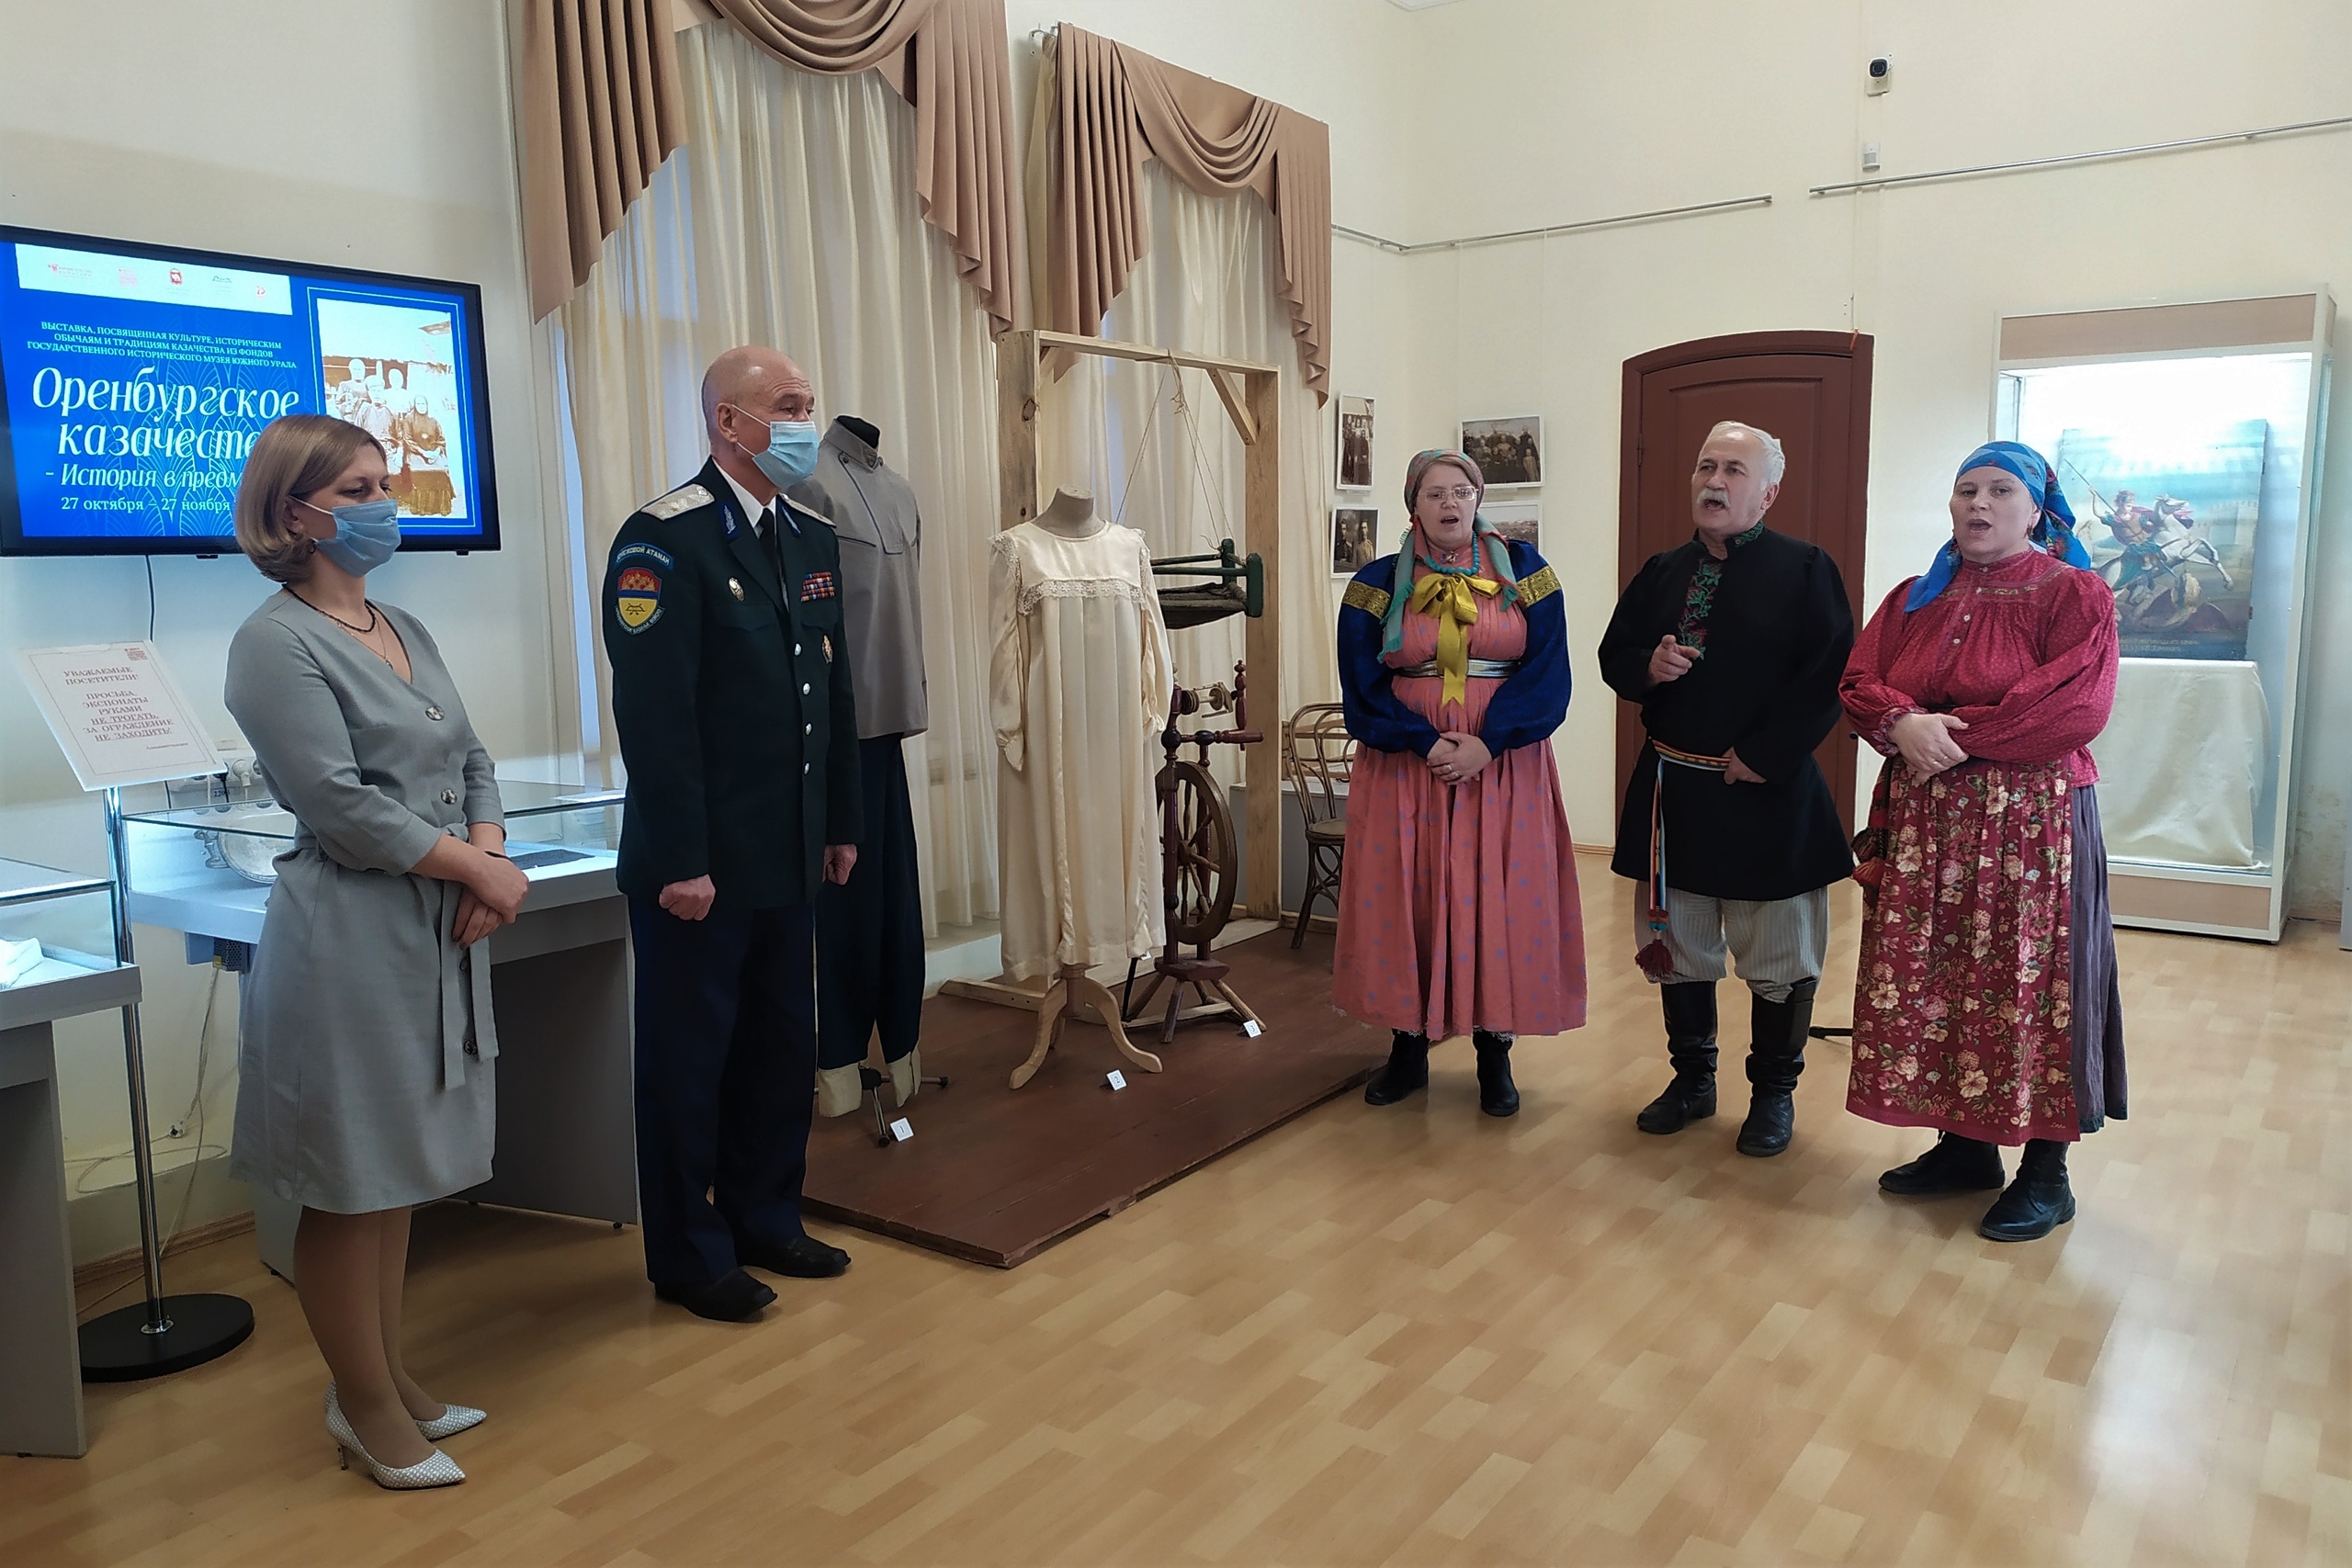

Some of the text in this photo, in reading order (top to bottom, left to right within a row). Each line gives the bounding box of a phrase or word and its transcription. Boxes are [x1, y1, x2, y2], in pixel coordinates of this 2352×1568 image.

[41, 321, 96, 334] ВЫСТАВКА,
[97, 326, 167, 340] ПОСВЯЩЕННАЯ
[215, 337, 282, 349] ИСТОРИЧЕСКИМ
[54, 333, 103, 344] ОБЫЧАЯМ
[113, 338, 170, 350] ТРАДИЦИЯМ
[171, 343, 225, 355] КАЗАЧЕСТВА
[226, 347, 238, 355] ИЗ
[239, 348, 274, 358] ФОНДОВ
[27, 341, 298, 368] ГОСУДАРСТВЕННОГО ИСТОРИЧЕСКОГО МУЗЕЯ ЮЖНОГО УРАЛА
[32, 366, 300, 423] Оренбургское
[58, 423, 263, 460] казачест
[61, 463, 157, 491] История
[164, 468, 177, 489] в
[62, 497, 79, 511] 27
[83, 497, 144, 513] октября
[161, 498, 177, 512] 27
[182, 498, 231, 513] ноября
[63, 666, 133, 677] УВАЖАЕМЫЕ
[83, 697, 149, 709] ЭКСПОНАТЫ
[98, 705, 142, 716] РУКАМИ
[91, 716, 107, 726] НЕ
[101, 719, 174, 732] ОГРАЖДЕНИЕ
[95, 734, 110, 742] НЕ
